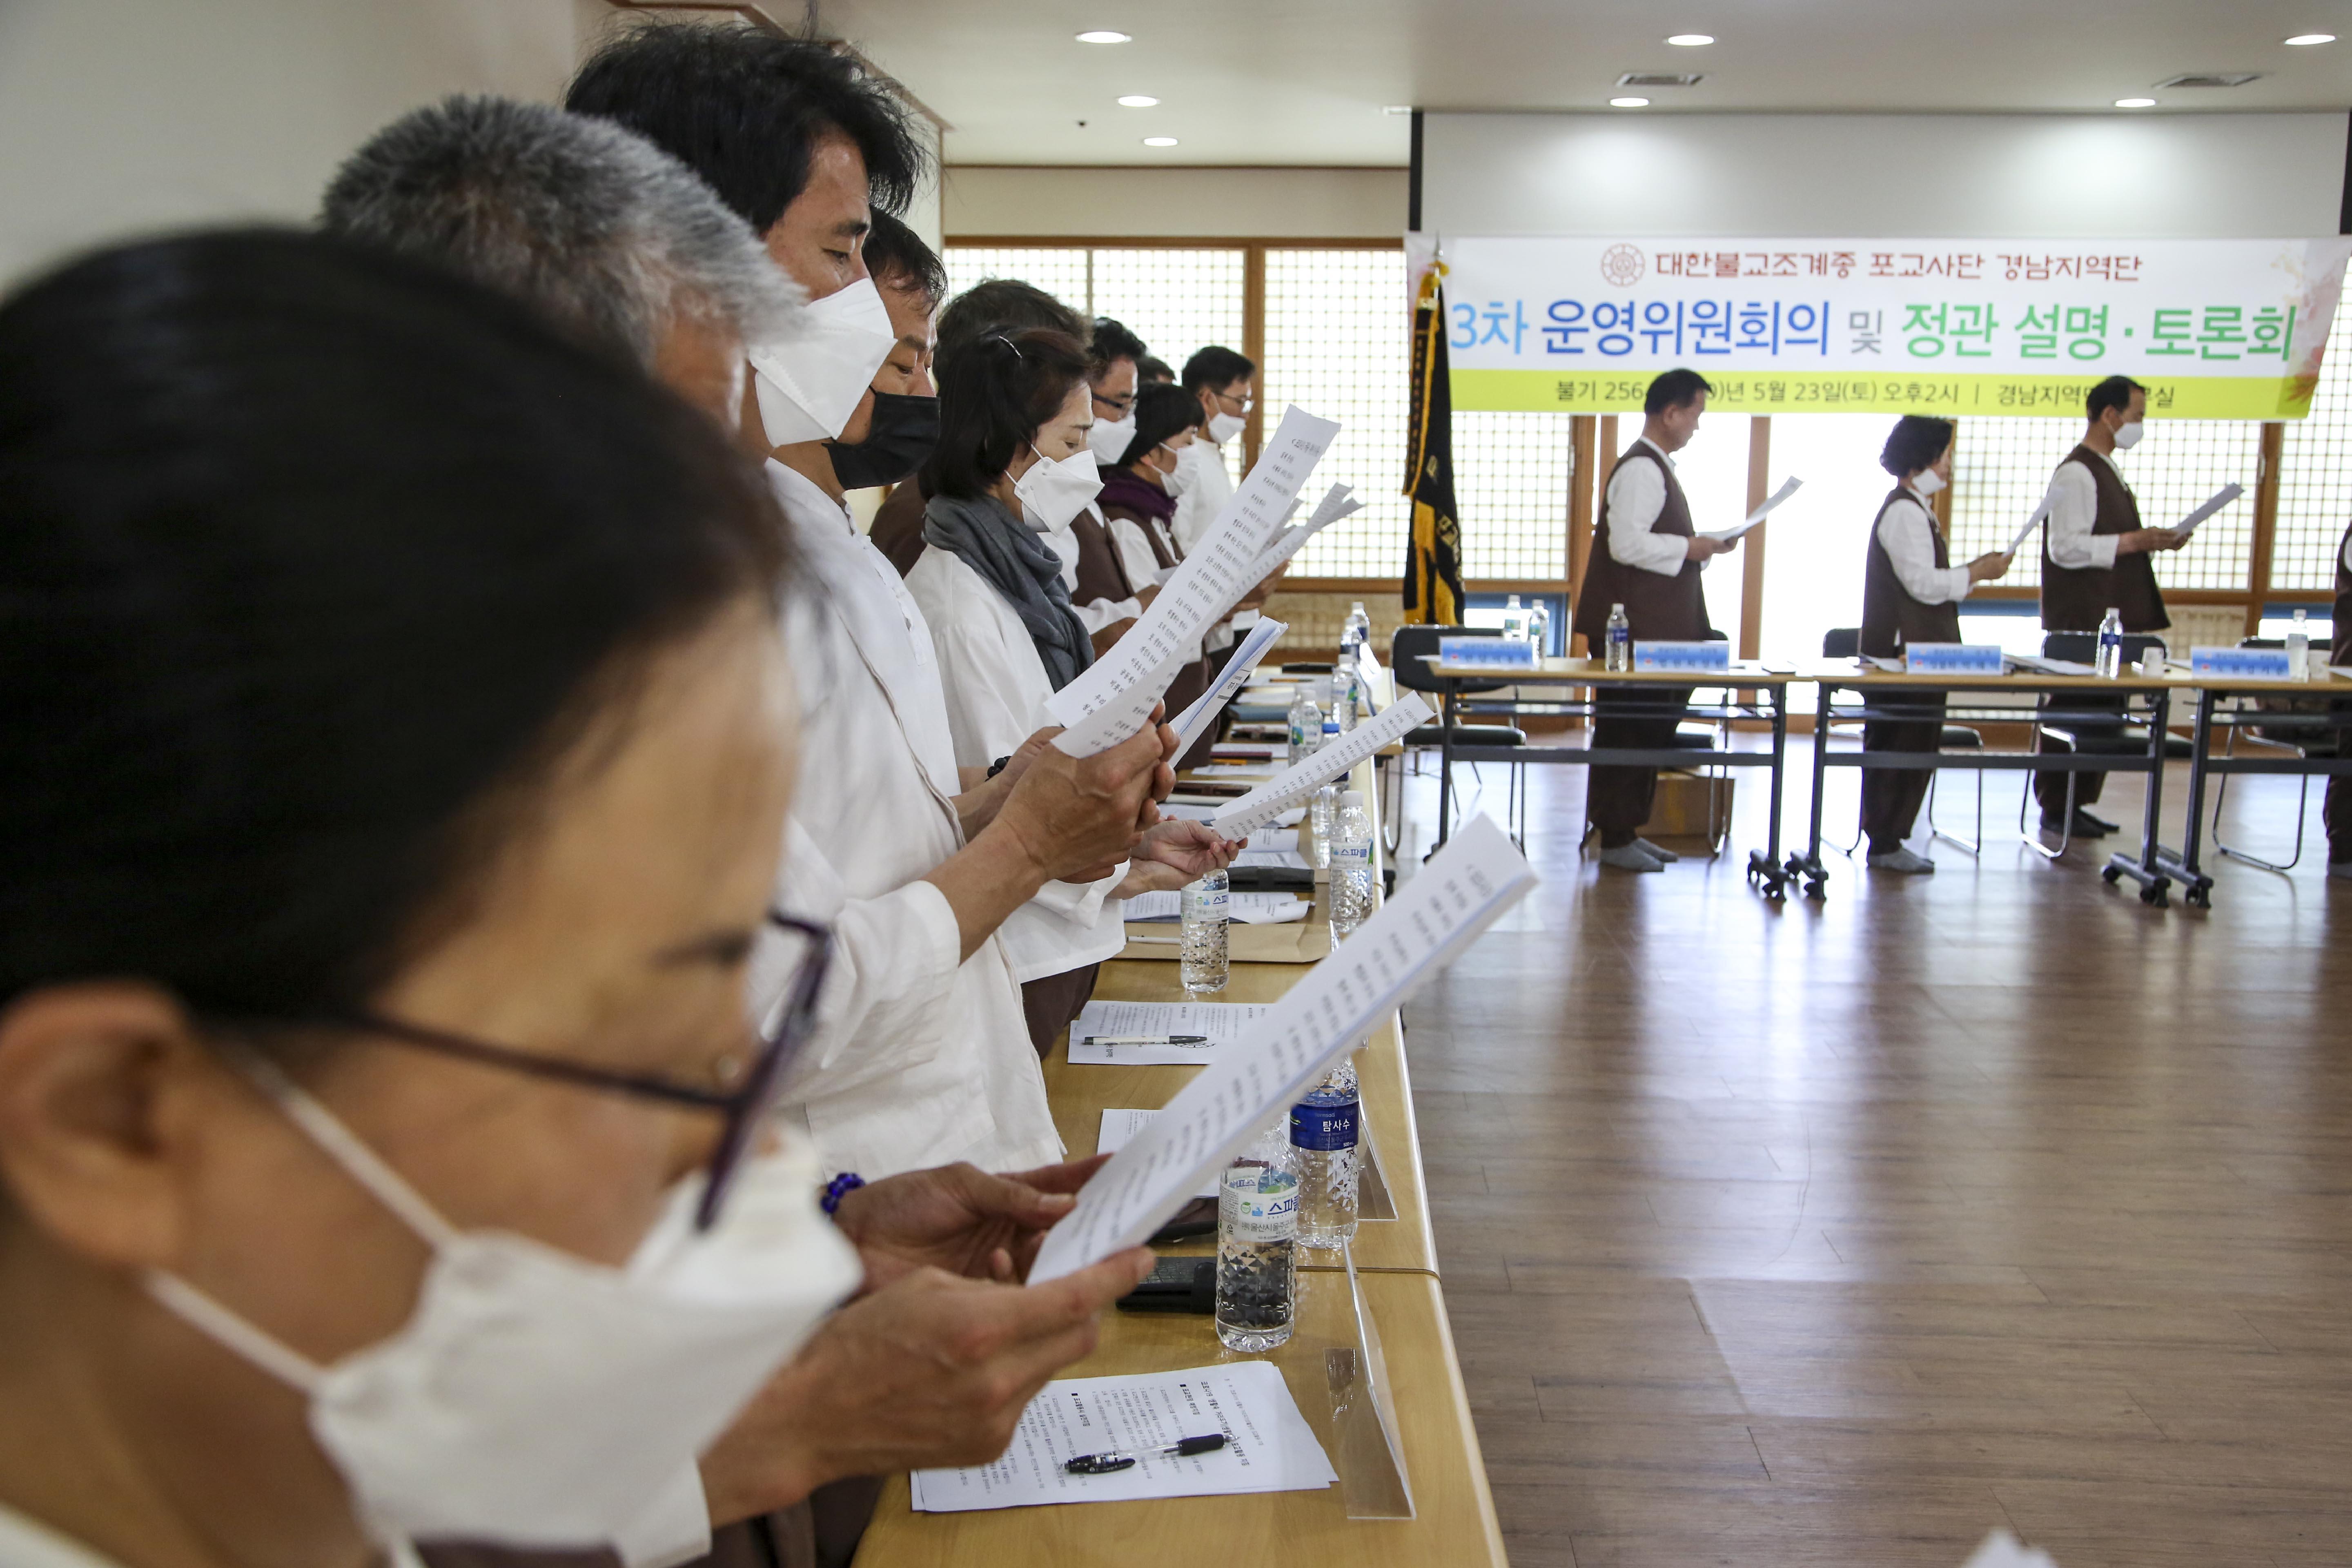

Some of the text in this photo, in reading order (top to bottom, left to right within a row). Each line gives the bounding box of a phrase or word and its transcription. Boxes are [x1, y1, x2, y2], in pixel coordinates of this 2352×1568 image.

[1656, 252, 2143, 282] 대한불교조계종 포교사단 경남지역단
[1541, 299, 1831, 356] 운영위원회의
[1849, 309, 1881, 354] 및
[1902, 303, 1999, 358] 정관
[1557, 380, 1597, 401] 불기
[1753, 381, 1786, 403] 5월
[1795, 381, 1877, 403] 23일(토)
[1883, 383, 1958, 403] 오후2시
[1998, 384, 2093, 407] 경남지역
[1322, 1118, 1350, 1132] 탐사수
